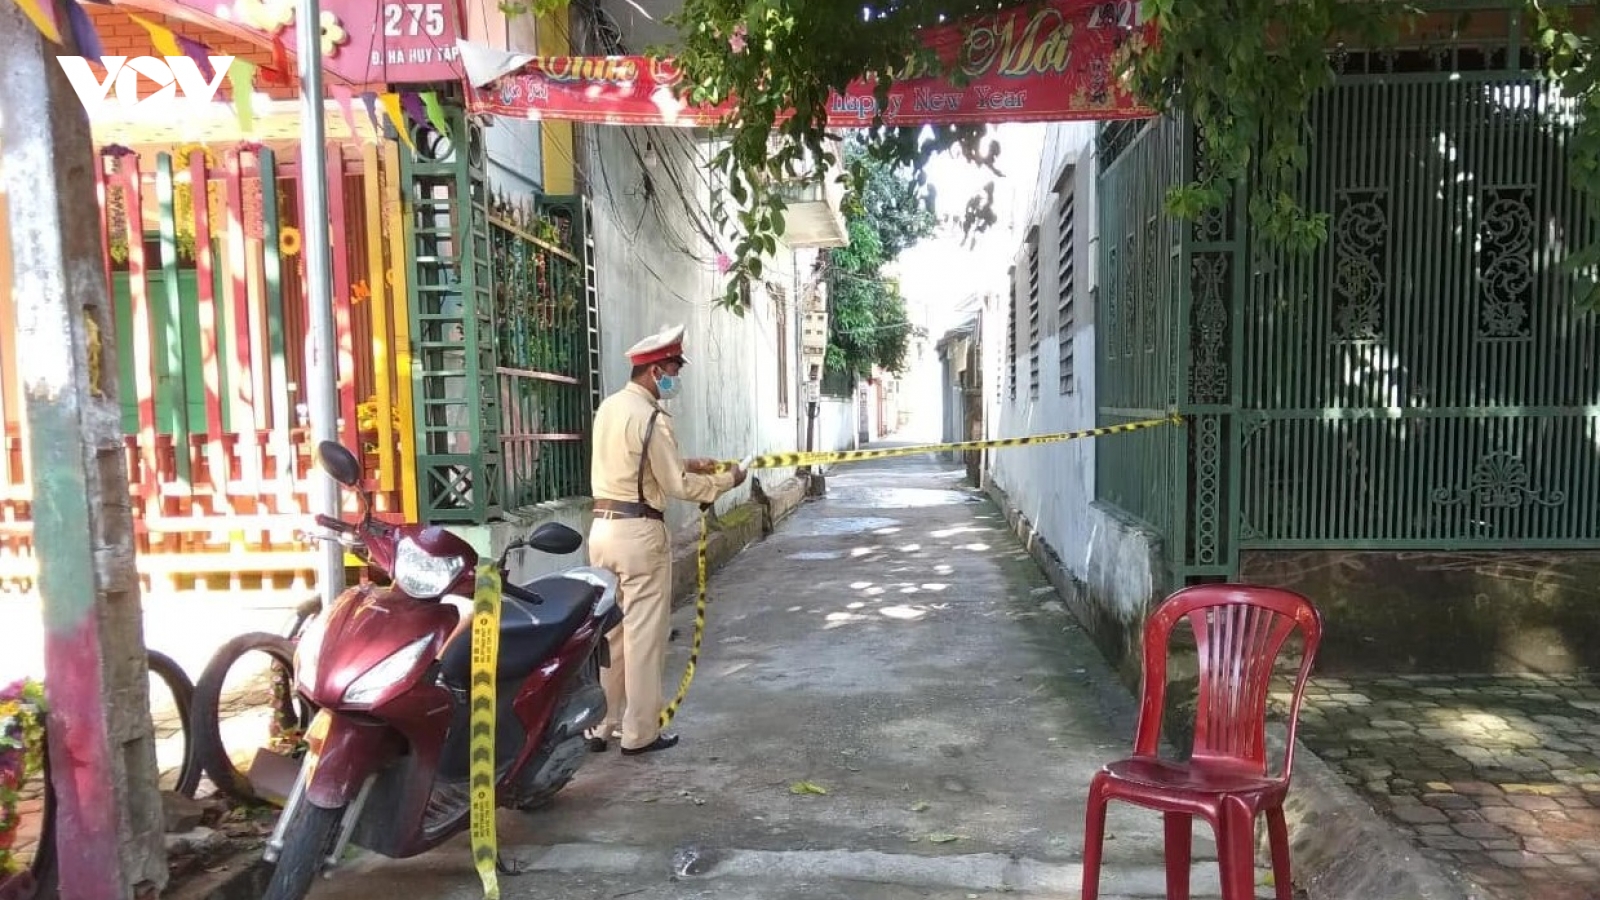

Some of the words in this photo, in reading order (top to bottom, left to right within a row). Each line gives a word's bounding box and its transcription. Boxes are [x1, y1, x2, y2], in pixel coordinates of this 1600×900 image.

[384, 3, 444, 36] 275
[408, 47, 432, 63] HUY
[831, 91, 904, 120] hapy
[914, 86, 963, 112] New
[974, 86, 1027, 109] Year
